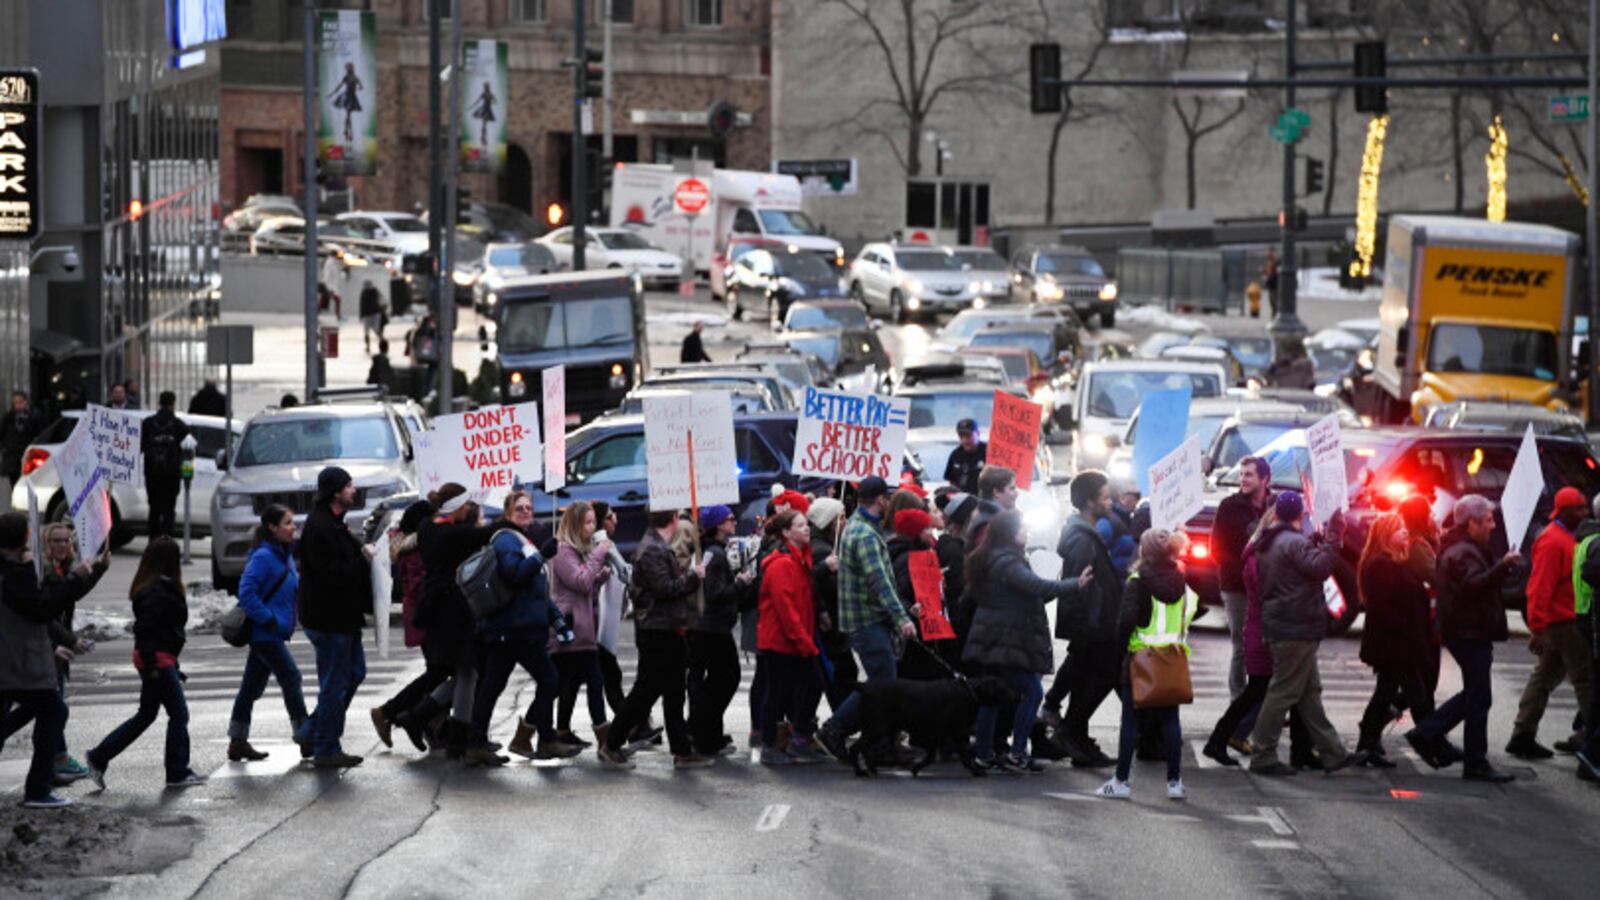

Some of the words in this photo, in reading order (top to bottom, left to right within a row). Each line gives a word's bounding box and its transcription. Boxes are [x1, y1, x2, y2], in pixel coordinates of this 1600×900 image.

[1435, 264, 1553, 287] PENSKE
[463, 407, 517, 430] DON'T
[805, 386, 864, 426] BETTER
[463, 424, 531, 451] UNDER-
[822, 420, 882, 453] BETTER
[464, 445, 521, 470] VALUE
[802, 443, 892, 478] SCHOOLS
[480, 469, 513, 489] ME!
